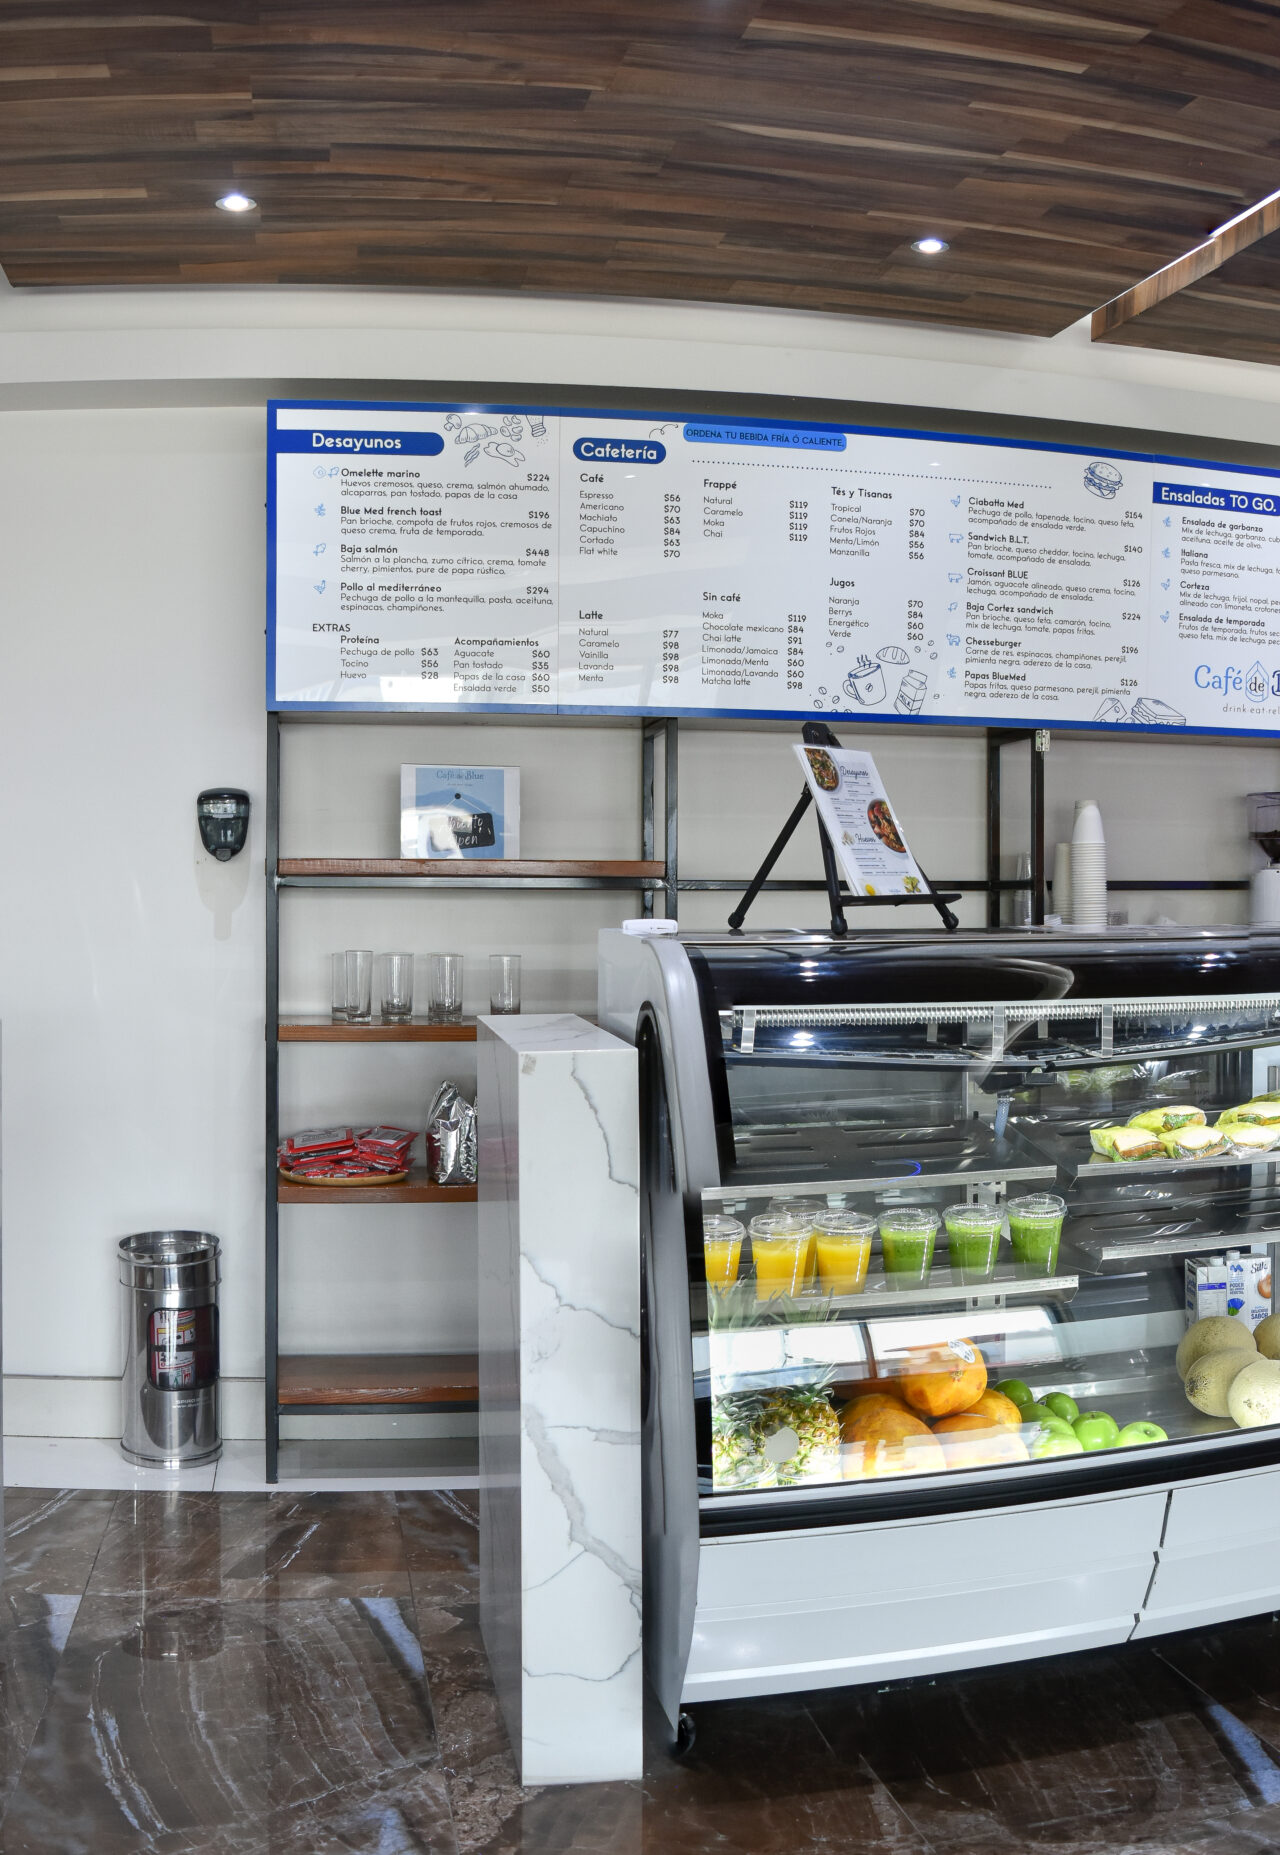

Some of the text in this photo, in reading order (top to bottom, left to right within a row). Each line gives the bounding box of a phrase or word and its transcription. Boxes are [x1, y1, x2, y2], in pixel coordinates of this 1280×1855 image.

[312, 433, 401, 451] Desayunos
[686, 429, 722, 438] ORDENA
[740, 432, 768, 442] BEBIDA
[772, 434, 789, 443] FRÍA
[793, 435, 799, 444] Ó
[581, 442, 656, 460] Cafetería
[341, 468, 550, 482] Omelette marino $224
[580, 473, 604, 483] Café
[341, 479, 370, 488] Huevos
[477, 481, 506, 490] salmón
[704, 479, 737, 492] Frappé
[580, 490, 680, 502] Espresso $56
[831, 487, 892, 499] Tés y Tisanas
[968, 497, 1024, 509] Ciabatta Med
[1162, 487, 1276, 512] Ensaladas TO GO.
[341, 506, 550, 520] Blue Med french toast $196
[580, 502, 680, 514] Americano $70
[831, 503, 925, 516] Tropical $70
[580, 513, 680, 525] Machiato $63
[830, 514, 925, 528] Canela/Naranja $70
[1182, 516, 1216, 527] Ensalada
[1229, 522, 1263, 532] garbanzo
[580, 524, 680, 536] Capuchino $84
[830, 525, 925, 538] Frutos Rojos $84
[580, 535, 680, 547] Cortado $63
[830, 536, 924, 550] Menta/Limón $56
[968, 532, 1142, 553] Sandwich B.L.T. $140
[340, 544, 549, 556] Baja salmón $448
[580, 547, 680, 558] Flat white $70
[830, 547, 924, 560] Manzanilla $56
[1181, 548, 1208, 558] Italiana
[830, 577, 855, 589] Jugos
[967, 568, 1140, 587] Croissant BLUE $126
[340, 582, 364, 591] Pollo
[378, 583, 442, 593] mediterráneo
[526, 586, 549, 595] $294
[1180, 580, 1210, 591] Corteza
[703, 592, 741, 602] Sin café
[579, 610, 603, 620] Latte
[966, 602, 1141, 620] Baja Cortez sandwich $224
[788, 614, 806, 622] $119
[1179, 613, 1213, 624] Ensalada
[1226, 617, 1265, 628] temporada
[312, 623, 350, 632] EXTRAS
[703, 622, 743, 631] Chocolate
[788, 625, 804, 634] $84
[340, 634, 379, 644] Proteína
[454, 637, 539, 648] Acompañamientos
[966, 636, 1138, 654] Chesseburger $196
[340, 647, 378, 657] Pechuga
[394, 648, 415, 658] pollo
[421, 648, 438, 656] $63
[454, 649, 550, 659] Aguacate $60
[340, 658, 438, 668] Tocino $56
[340, 670, 438, 680] Huevo $28
[964, 670, 1138, 686] Papas BlueMed $126
[1194, 664, 1242, 696] Café
[1249, 676, 1264, 693] de
[436, 770, 484, 780] Café Blue
